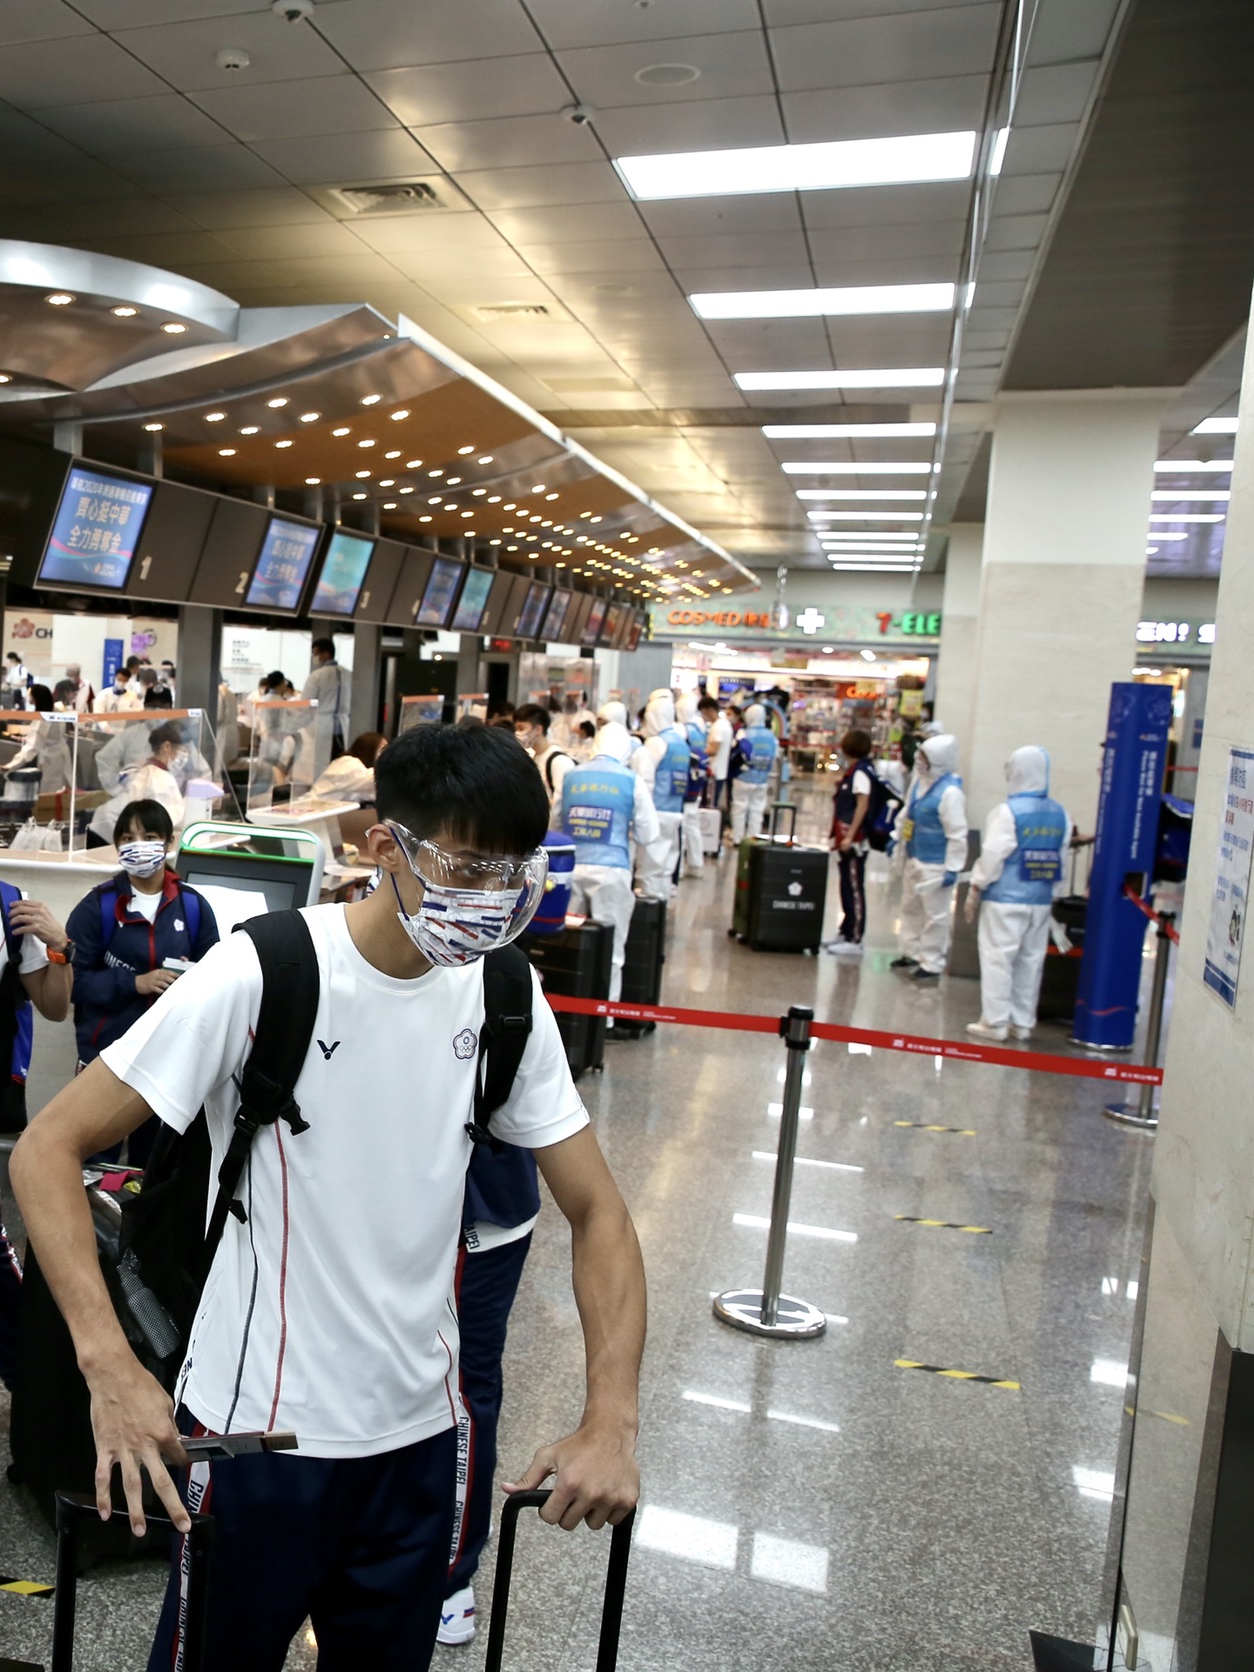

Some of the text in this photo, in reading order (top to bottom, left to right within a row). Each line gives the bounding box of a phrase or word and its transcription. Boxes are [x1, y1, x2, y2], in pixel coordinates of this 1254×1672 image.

[140, 556, 153, 580] 1
[234, 571, 249, 594] 2
[667, 610, 741, 627] COSMED
[875, 611, 941, 636] 7-ELE
[462, 1223, 482, 1251] AIPEI
[455, 1416, 470, 1485] CHINESE TAIPEI
[187, 1479, 205, 1514] CHIN
